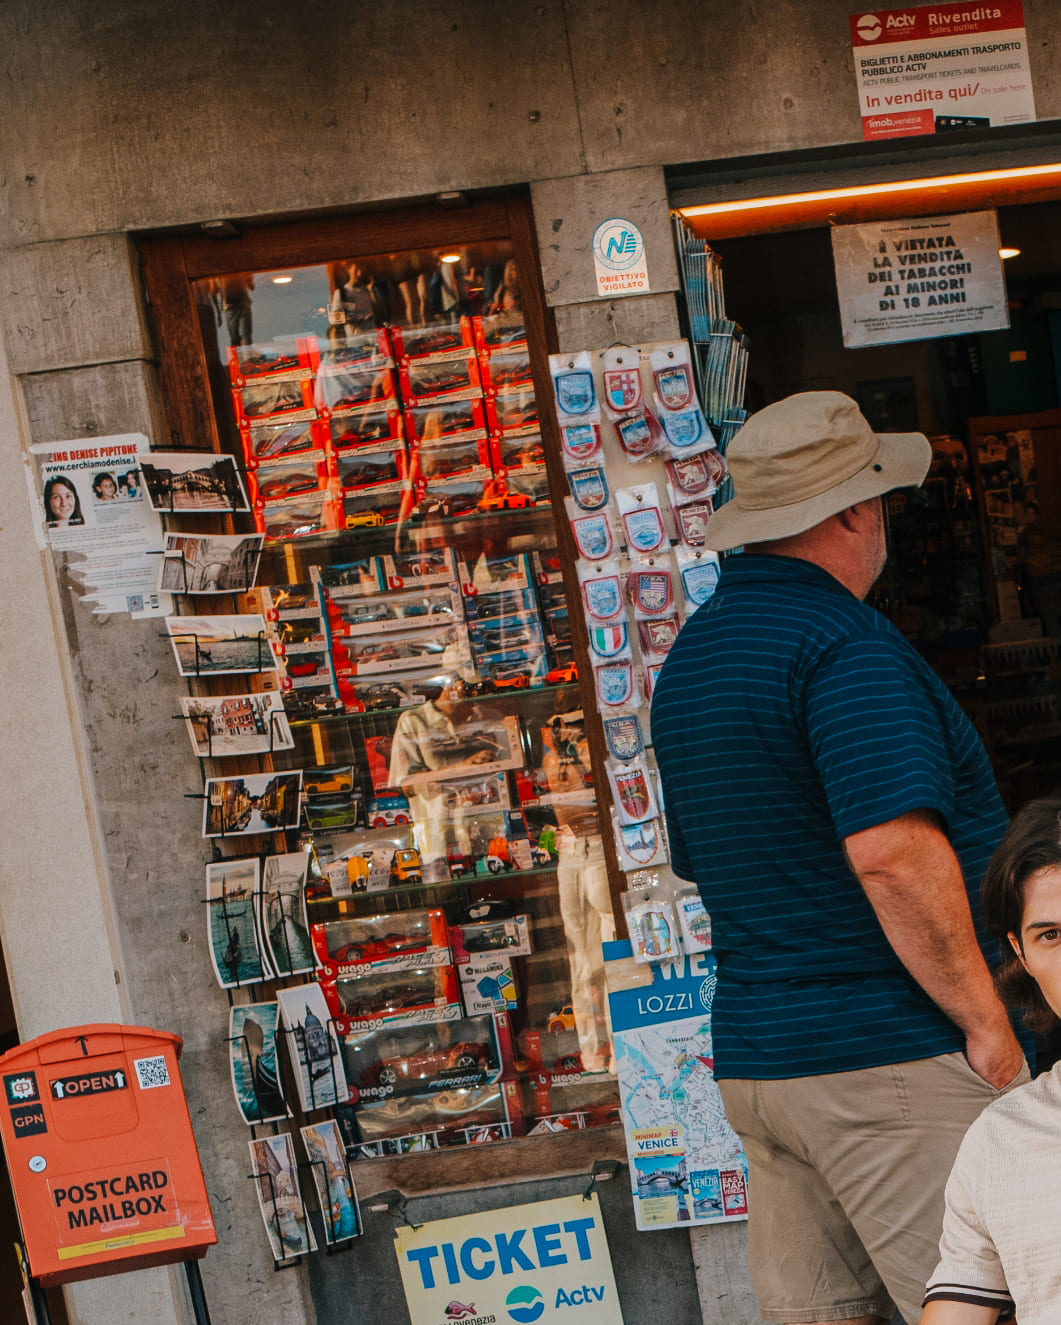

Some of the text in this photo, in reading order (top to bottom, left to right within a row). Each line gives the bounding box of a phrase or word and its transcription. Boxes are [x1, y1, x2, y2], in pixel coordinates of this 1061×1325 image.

[886, 8, 1001, 29] Actv Rivendita
[929, 23, 978, 35] Sales outlet
[860, 55, 899, 67] BIGLIETTI
[907, 47, 970, 63] ABBONAMENTI
[971, 42, 1021, 55] TRASPORTO
[862, 62, 927, 77] PUBBLICO ACTV
[880, 76, 901, 85] PUBLIC
[902, 72, 937, 82] TRANSPORT
[866, 95, 880, 108] In
[884, 89, 943, 106] vendita
[893, 235, 956, 252] VIETATA
[873, 249, 964, 268] LA VENDITA
[600, 272, 646, 283] OBIETTIVO
[867, 262, 972, 283] DEI TABACCHI
[603, 281, 644, 291] VIGILATO
[884, 277, 965, 297] AI MINORI
[879, 291, 967, 312] DI 18 ANNI
[70, 447, 99, 461] DENISE
[100, 443, 138, 459] PIPITONE
[45, 455, 136, 473] www.cerchiamodenise.i
[637, 993, 693, 1014] LOZZI
[65, 1074, 115, 1095] OPEN
[14, 1113, 44, 1129] GPN
[638, 1138, 678, 1150] VENICE
[54, 1170, 168, 1207] POSTCARD
[692, 1176, 718, 1188] VENEZIA
[723, 1182, 744, 1190] MAP
[68, 1194, 167, 1229] MAILBOX
[406, 1217, 596, 1290] TICKET
[554, 1285, 605, 1308] Actv
